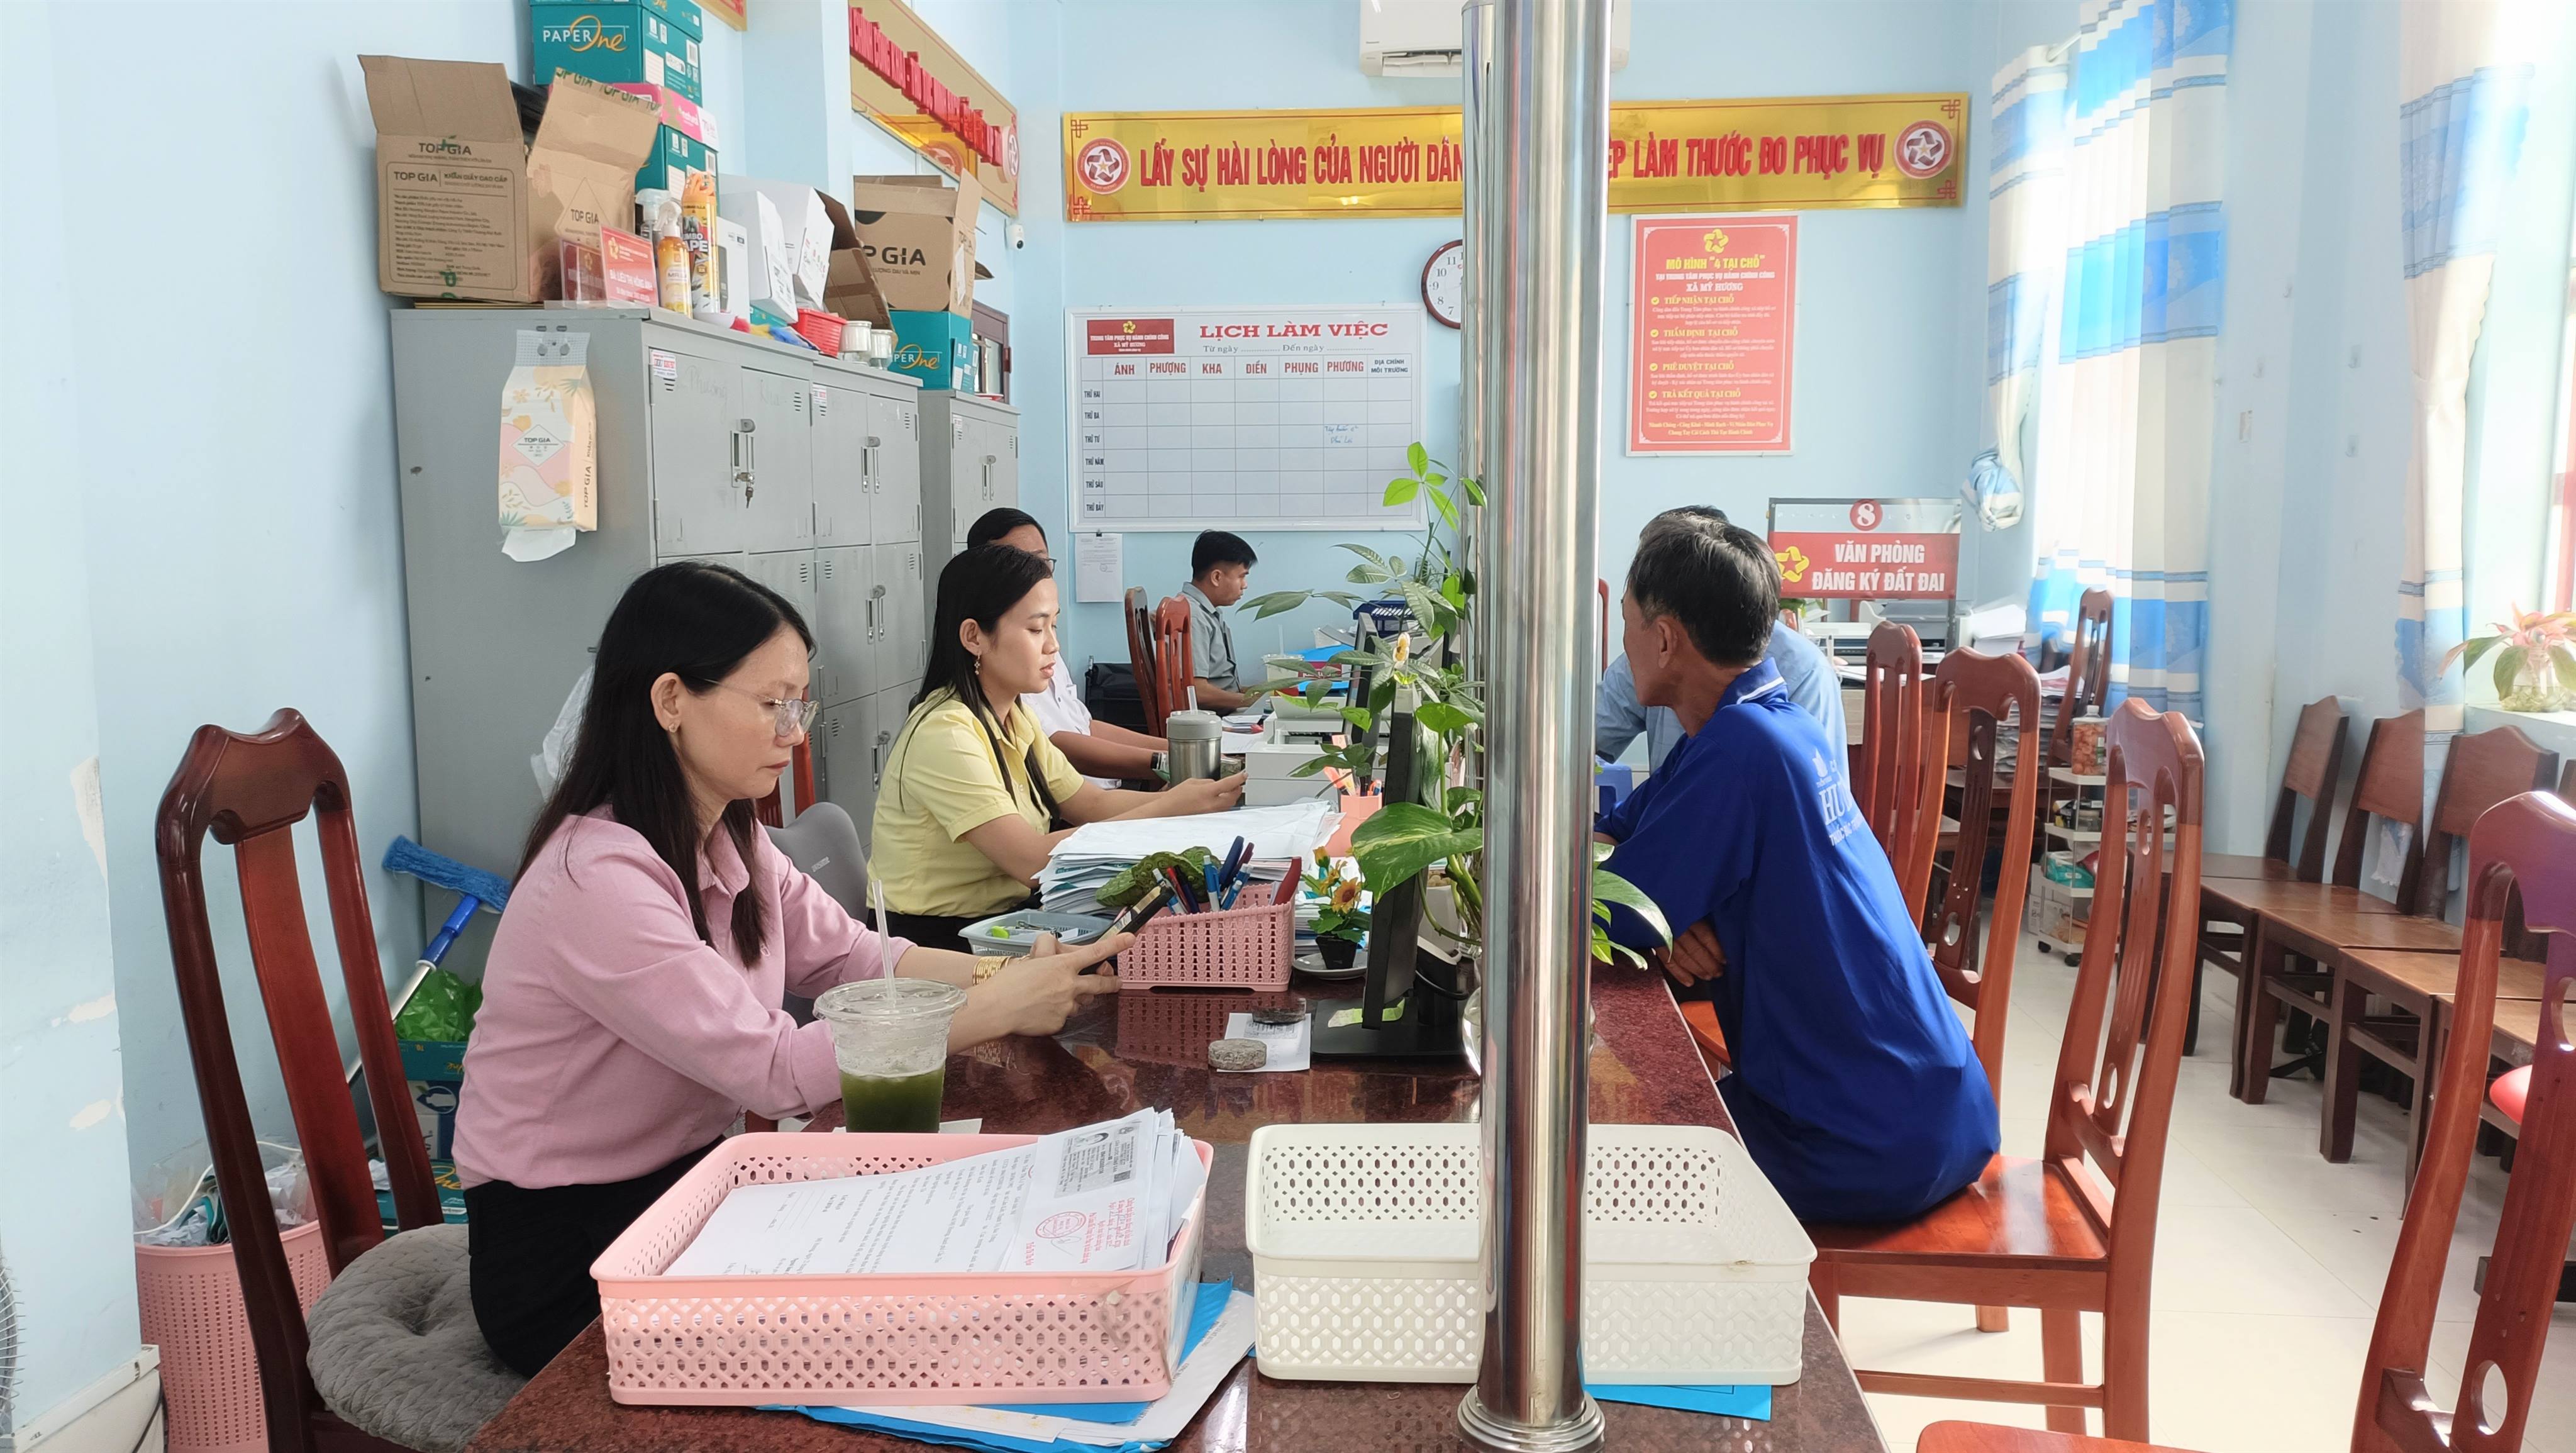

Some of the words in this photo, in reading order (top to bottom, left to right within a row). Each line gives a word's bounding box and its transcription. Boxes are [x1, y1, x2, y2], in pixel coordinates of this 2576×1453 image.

[543, 29, 592, 43] PAPER
[1140, 136, 1174, 187] LẤY
[1182, 143, 1209, 192] SỰ
[1217, 140, 1250, 186] HÀI
[1257, 138, 1307, 186] LÒNG
[1314, 133, 1353, 185] CỦA
[1359, 136, 1420, 183] NGƯỜI
[1634, 131, 1679, 178] LÀM
[1686, 130, 1753, 177] THƯỚC
[1794, 134, 1849, 181] PHỤC
[1858, 133, 1886, 179] VỤ
[394, 171, 416, 182] TOP
[418, 172, 438, 182] GIA
[570, 209, 584, 222] TOP
[585, 211, 599, 224] GIA
[882, 247, 926, 266] GIA
[1447, 256, 1456, 265] 11
[1666, 257, 1682, 270] MÔ
[1684, 256, 1707, 269] HÌNH
[1723, 257, 1738, 271] TẠI
[1436, 268, 1446, 277] 10
[1432, 281, 1439, 290] 9
[1437, 296, 1444, 305] 8
[1448, 306, 1454, 315] 7
[1199, 325, 1260, 342] LỊCH
[1267, 321, 1321, 338] LÀM
[1328, 320, 1389, 340] VIỆC
[1218, 345, 1240, 354] ngày
[1282, 343, 1302, 352] Đến
[1304, 344, 1325, 353] ngày
[894, 354, 915, 363] PER
[1150, 361, 1186, 376] PHƯỢNG
[1202, 363, 1222, 374] KHA
[1284, 362, 1319, 376] PHỤNG
[1327, 360, 1364, 372] PHƯƠNG
[1857, 503, 1876, 526] 8
[1835, 540, 1867, 563] VĂN
[1870, 540, 1925, 563] PHÒNG
[1812, 568, 1855, 591] ĐĂNG
[1859, 568, 1880, 591] KÝ
[1884, 566, 1914, 591] ĐẤT
[1918, 572, 1945, 591] ĐAI
